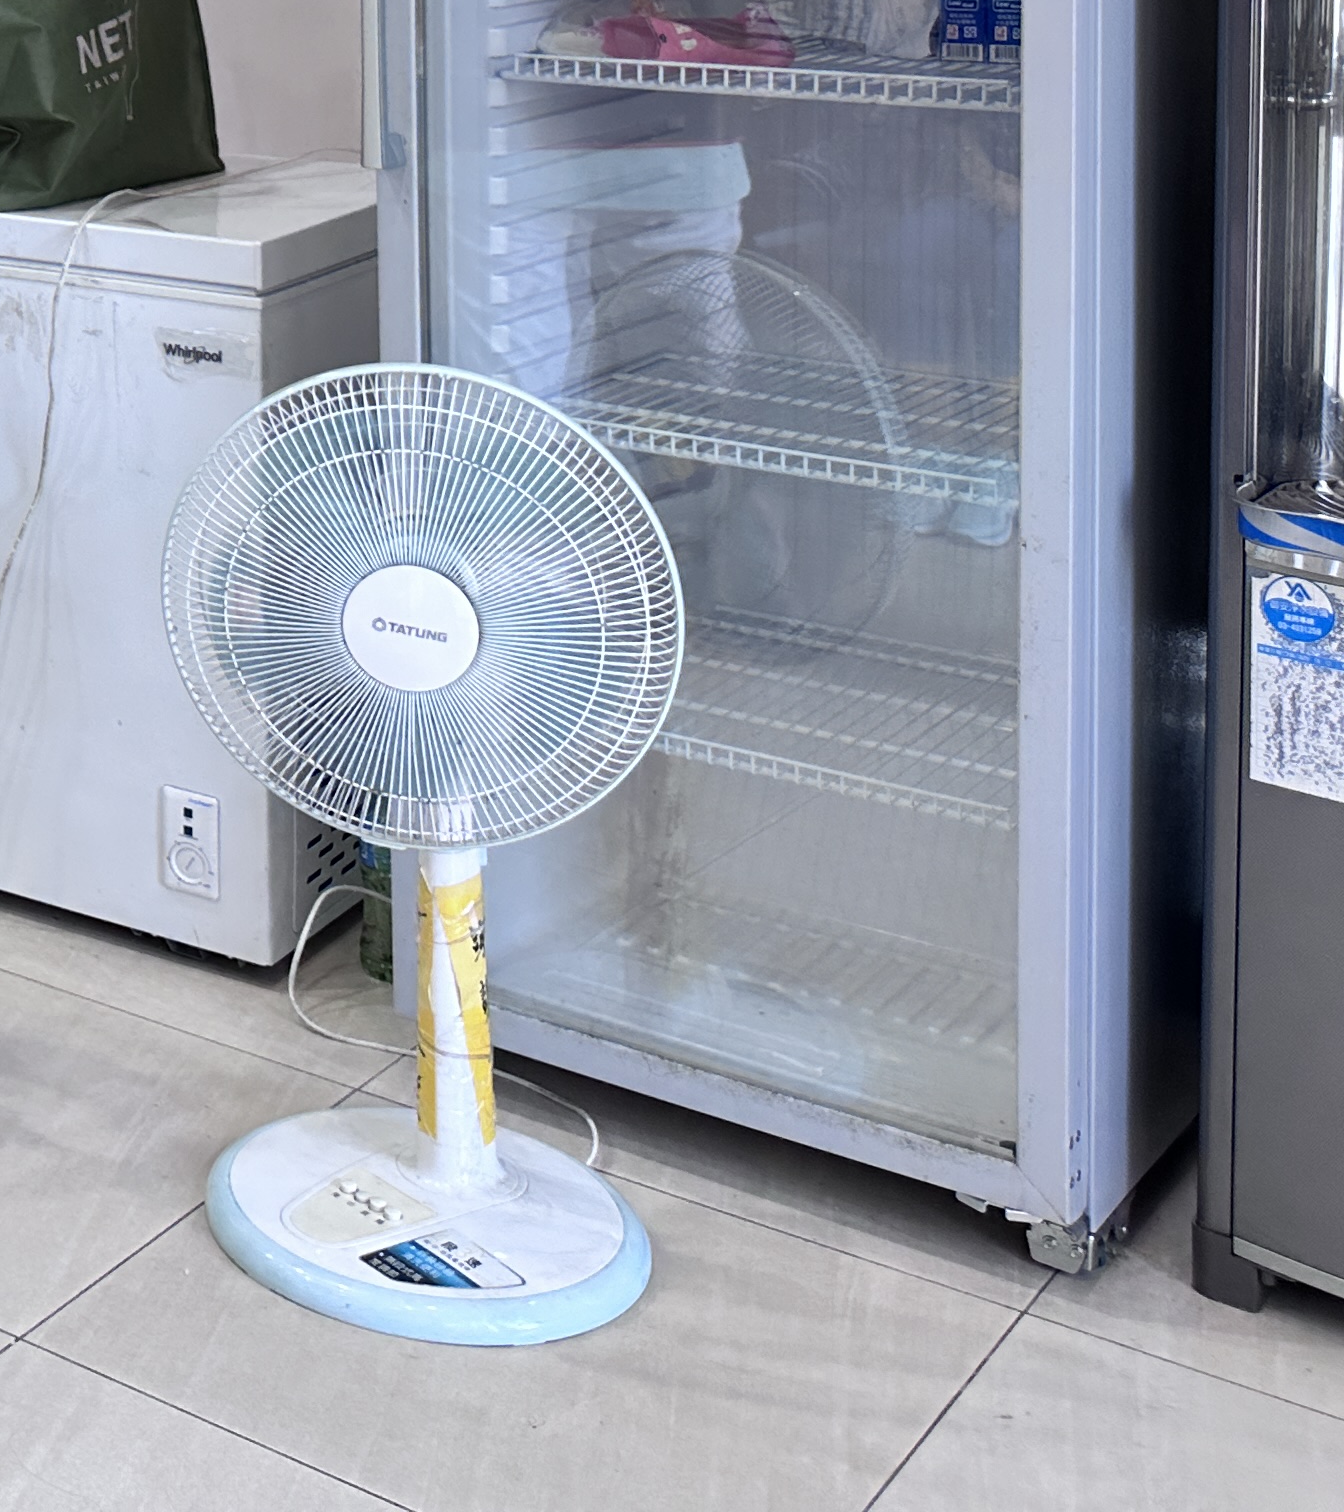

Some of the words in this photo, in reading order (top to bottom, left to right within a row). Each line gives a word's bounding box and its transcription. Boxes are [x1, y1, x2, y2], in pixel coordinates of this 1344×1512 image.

[75, 9, 133, 75] NET
[163, 342, 223, 364] Whirlpool
[388, 621, 448, 643] TATUNG
